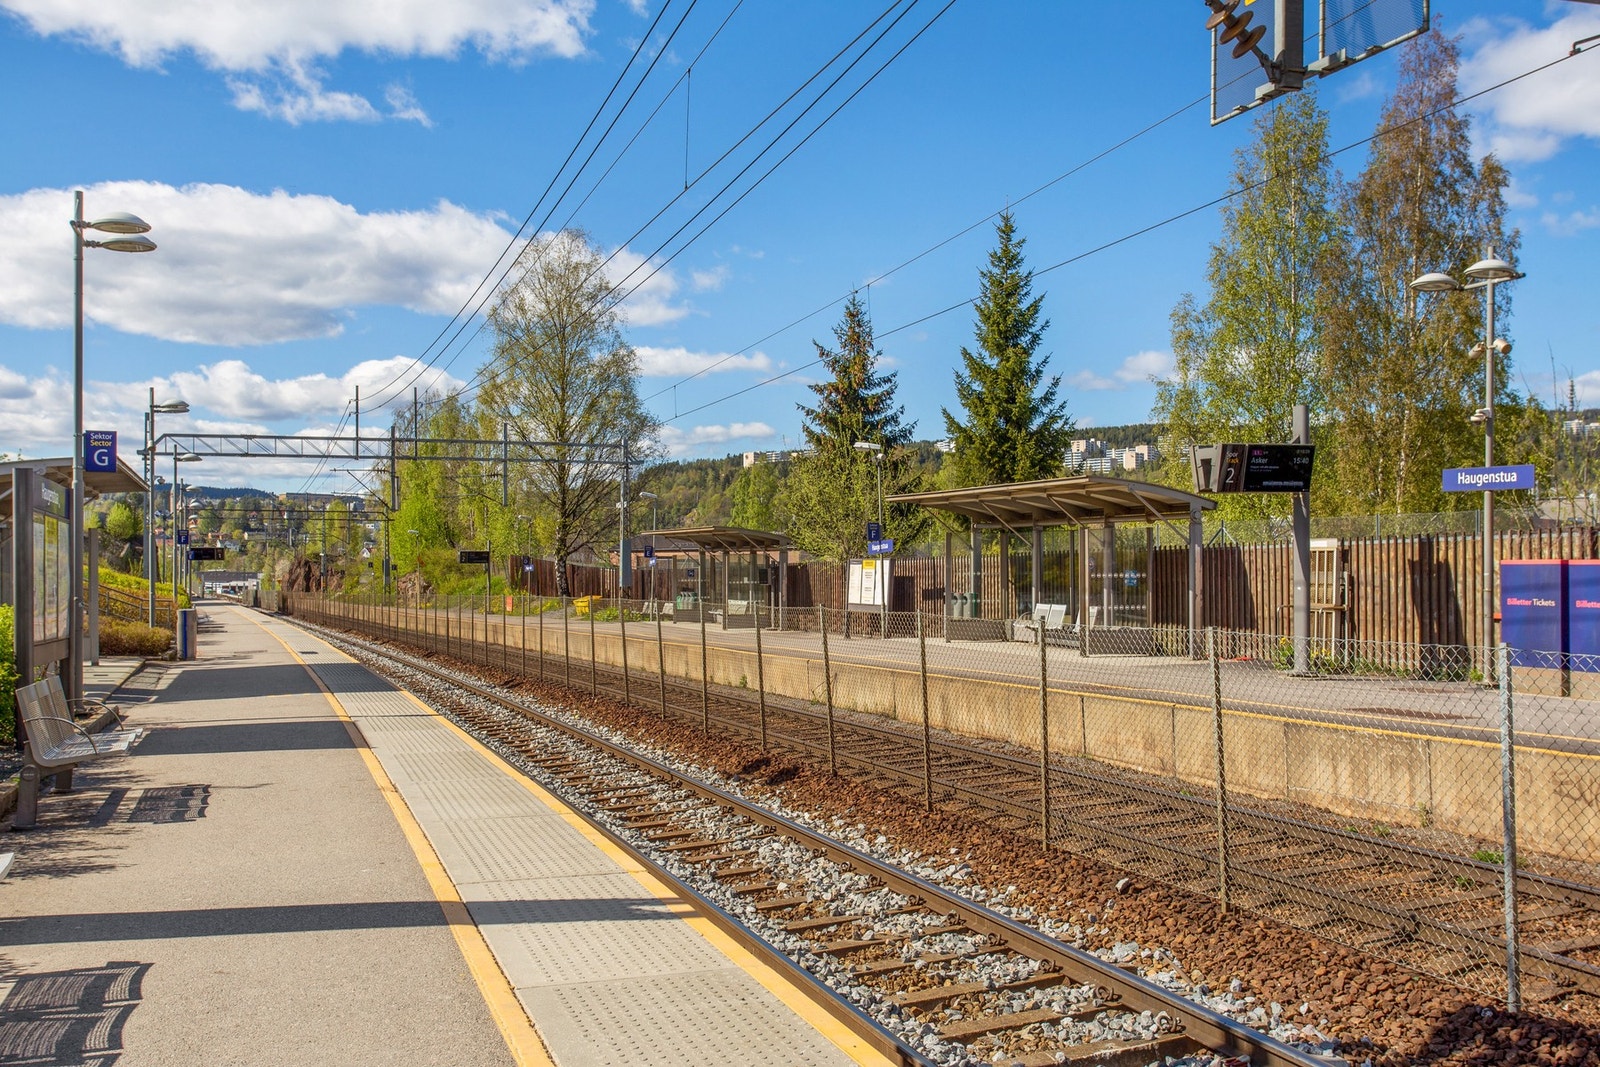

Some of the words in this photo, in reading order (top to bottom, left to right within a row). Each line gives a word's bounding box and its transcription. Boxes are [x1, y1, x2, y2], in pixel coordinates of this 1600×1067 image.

[94, 448, 108, 466] G
[1226, 468, 1234, 483] 2
[1457, 472, 1517, 486] Haugenstua
[1506, 598, 1532, 606] Billetter
[1532, 598, 1556, 606] Tickets
